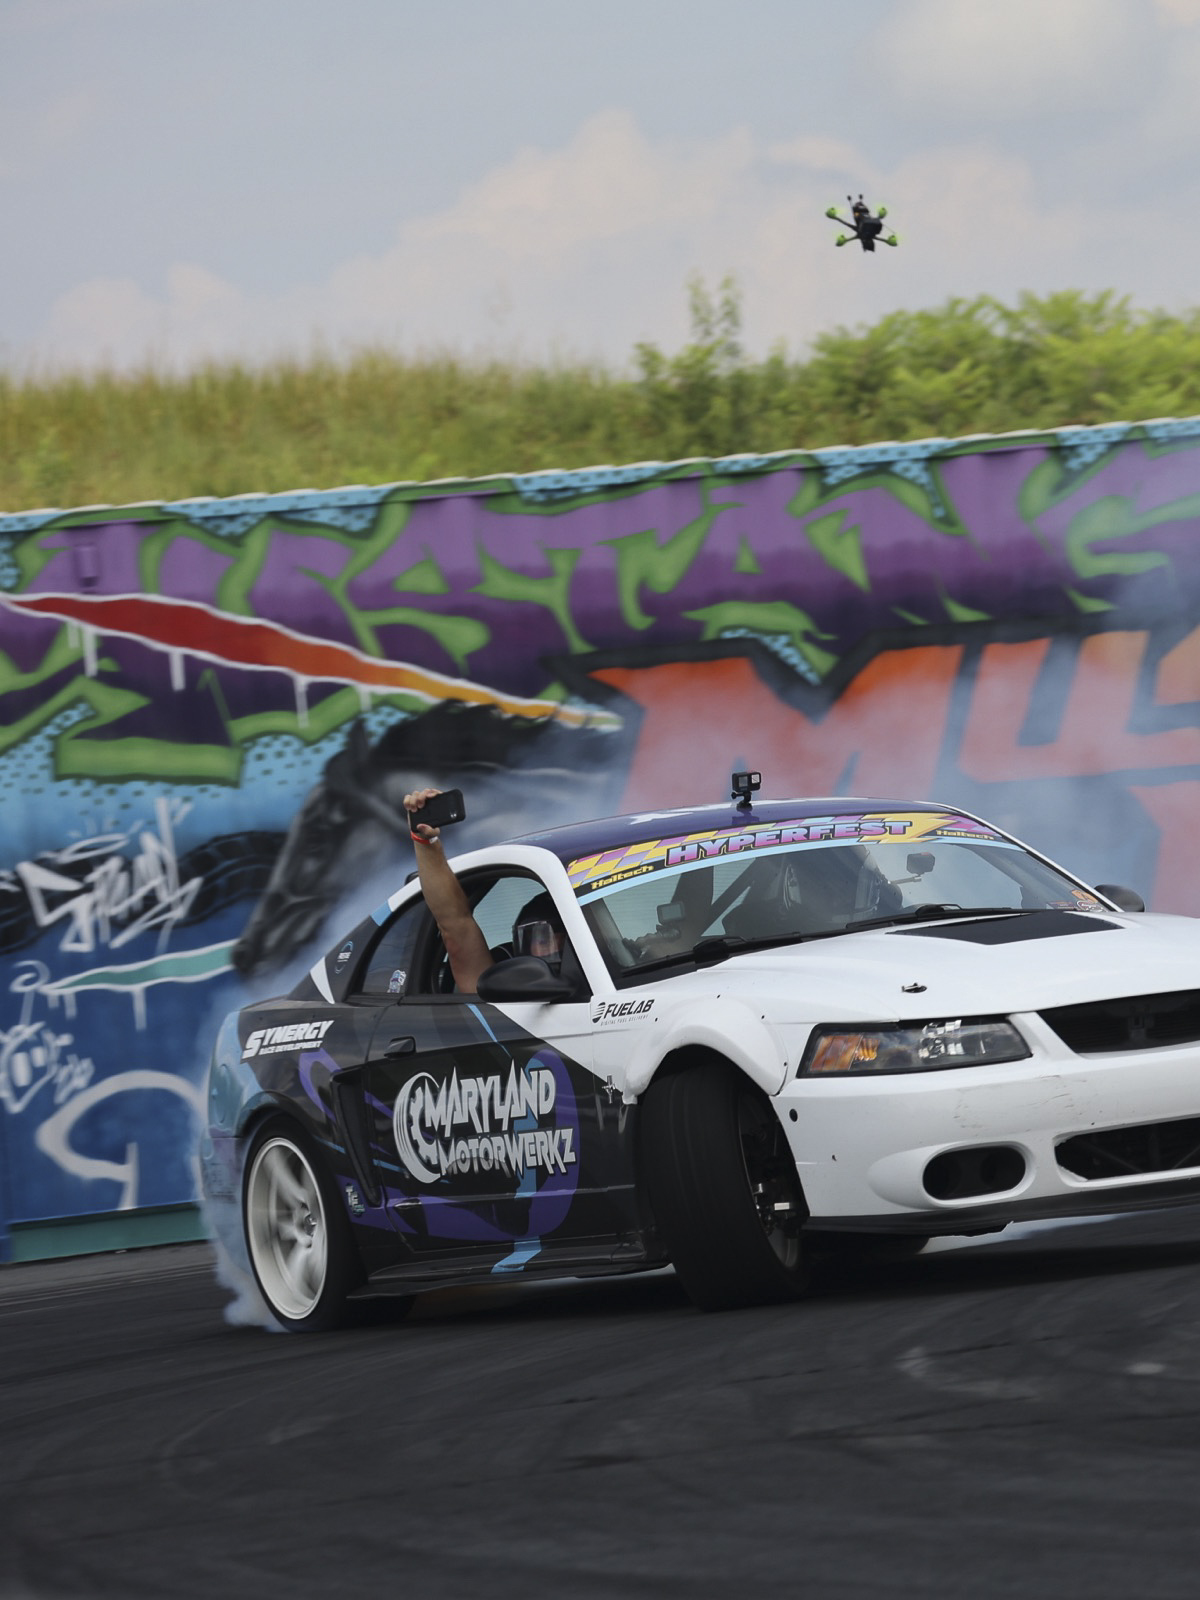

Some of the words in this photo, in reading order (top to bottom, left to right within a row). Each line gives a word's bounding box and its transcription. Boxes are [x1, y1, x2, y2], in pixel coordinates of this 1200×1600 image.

[665, 820, 912, 866] HYPERFEST
[935, 829, 995, 840] Haltech
[591, 864, 654, 890] Haltech
[603, 998, 656, 1019] FUELAB
[242, 1020, 335, 1059] SYNERGY
[275, 1040, 324, 1053] DEVELOPMENT
[424, 1059, 556, 1137] MARYLAND
